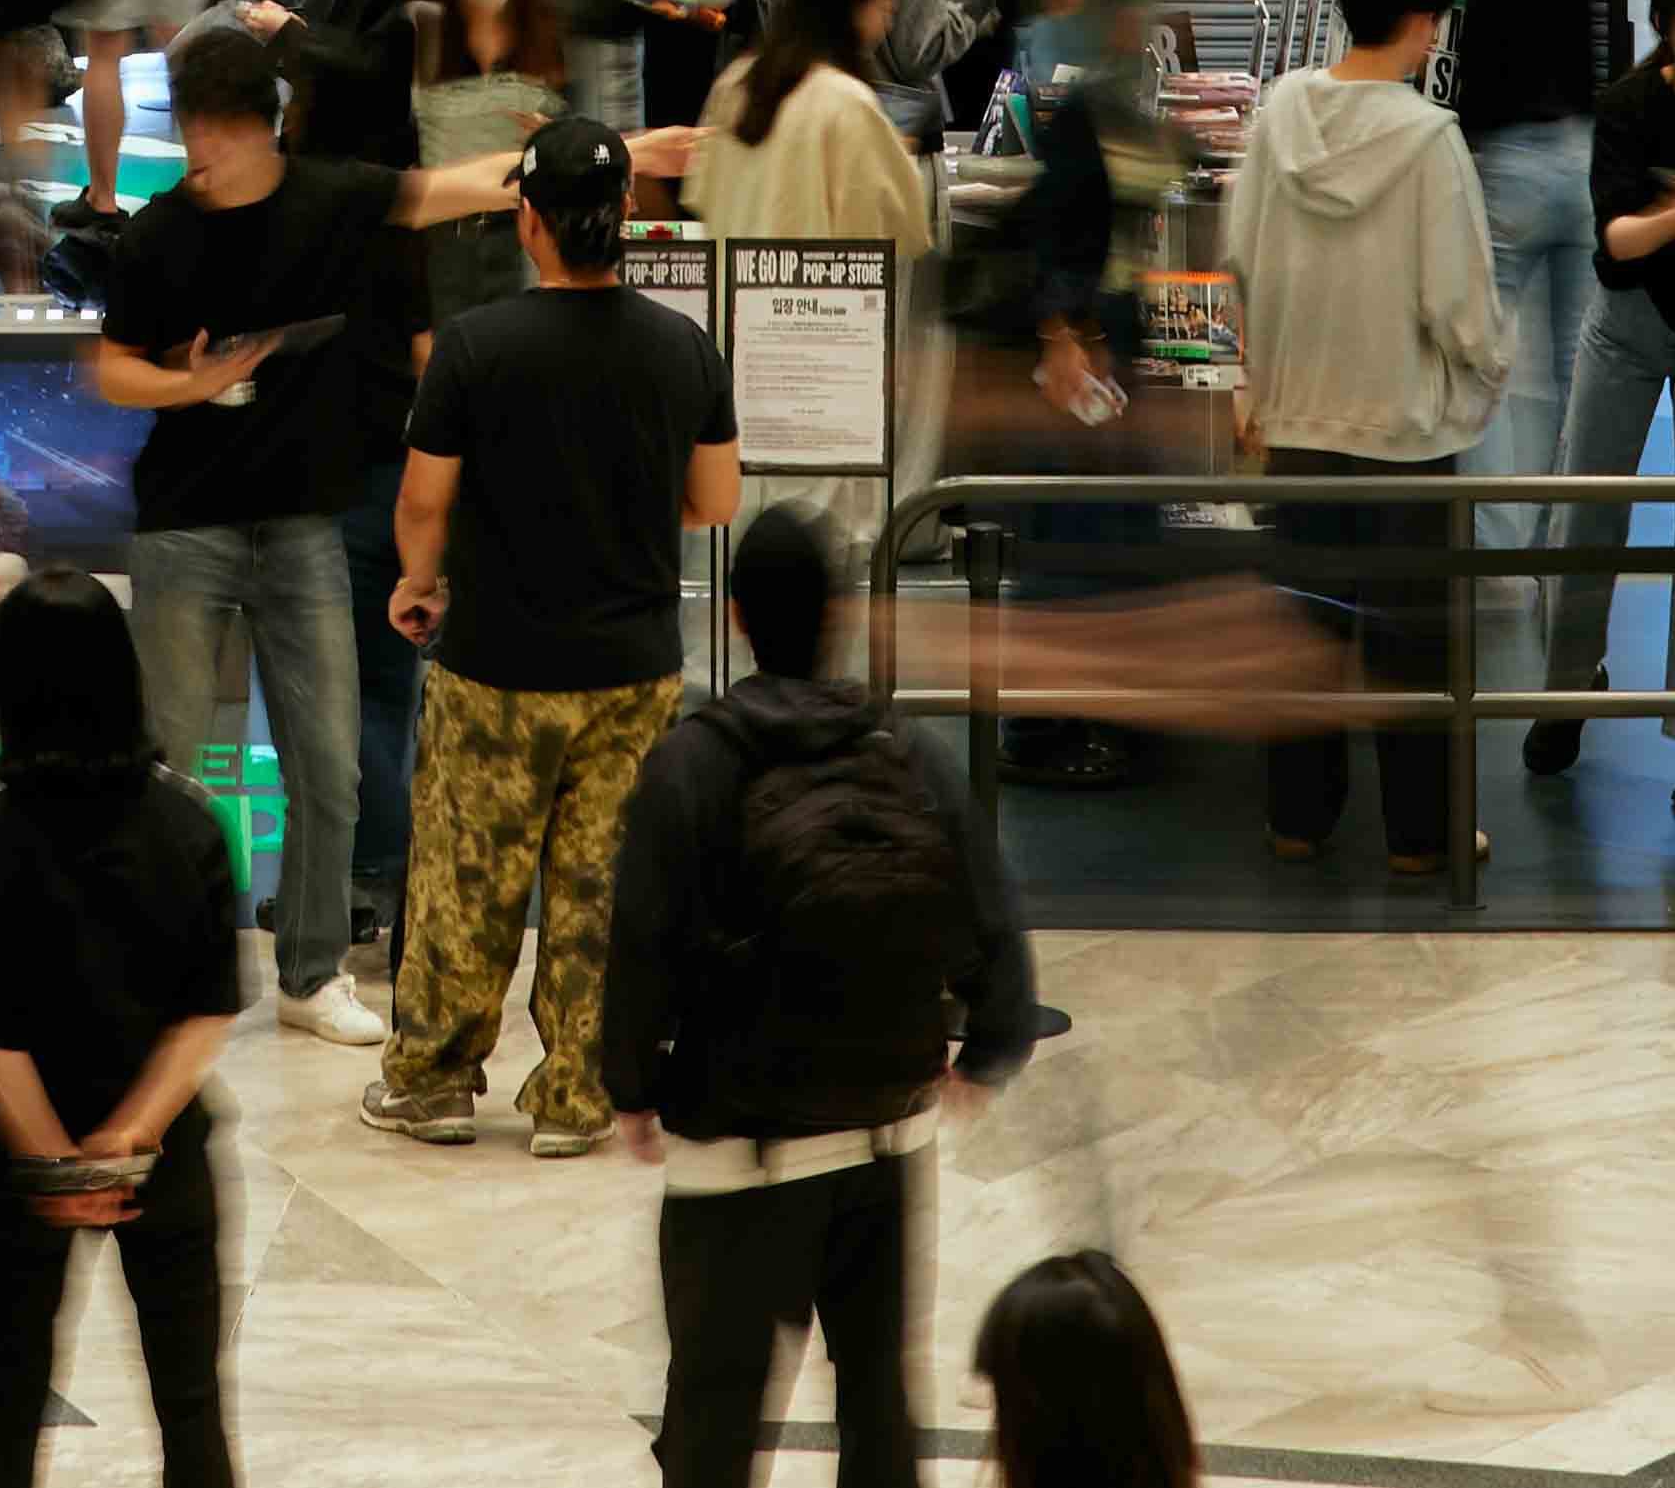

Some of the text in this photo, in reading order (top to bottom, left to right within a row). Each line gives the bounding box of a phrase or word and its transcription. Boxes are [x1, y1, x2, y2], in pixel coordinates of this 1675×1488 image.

[625, 261, 707, 285] POP-UP STORE
[736, 248, 884, 285] WE GO UP POP-UP STORE
